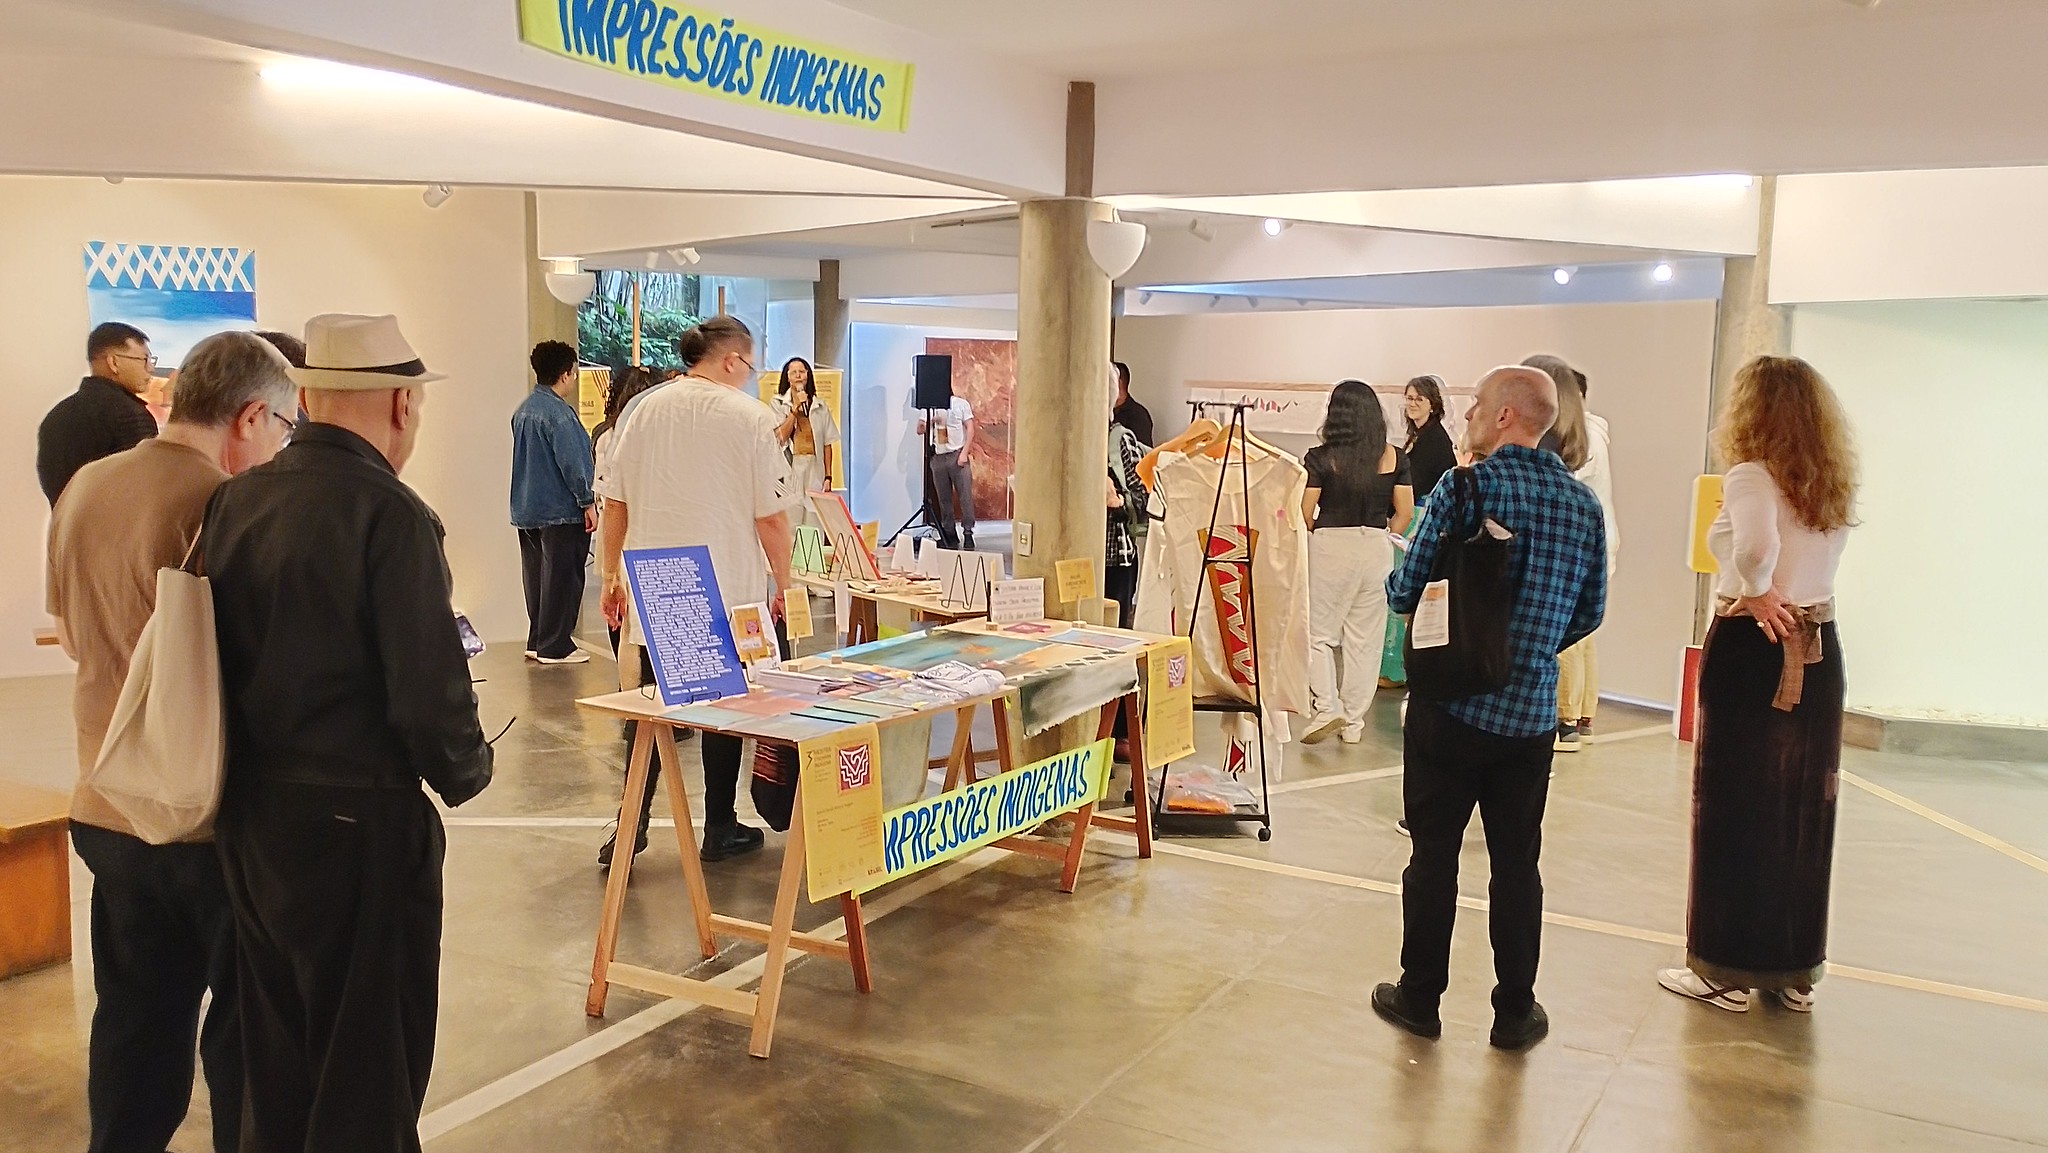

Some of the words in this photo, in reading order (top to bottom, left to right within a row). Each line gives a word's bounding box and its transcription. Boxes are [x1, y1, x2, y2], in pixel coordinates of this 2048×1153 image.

[559, 0, 763, 95] IMPRESSÕES
[759, 44, 885, 121] INDIGENAS
[883, 784, 997, 874] MPRESSÕES
[997, 750, 1091, 833] INDIGENAS
